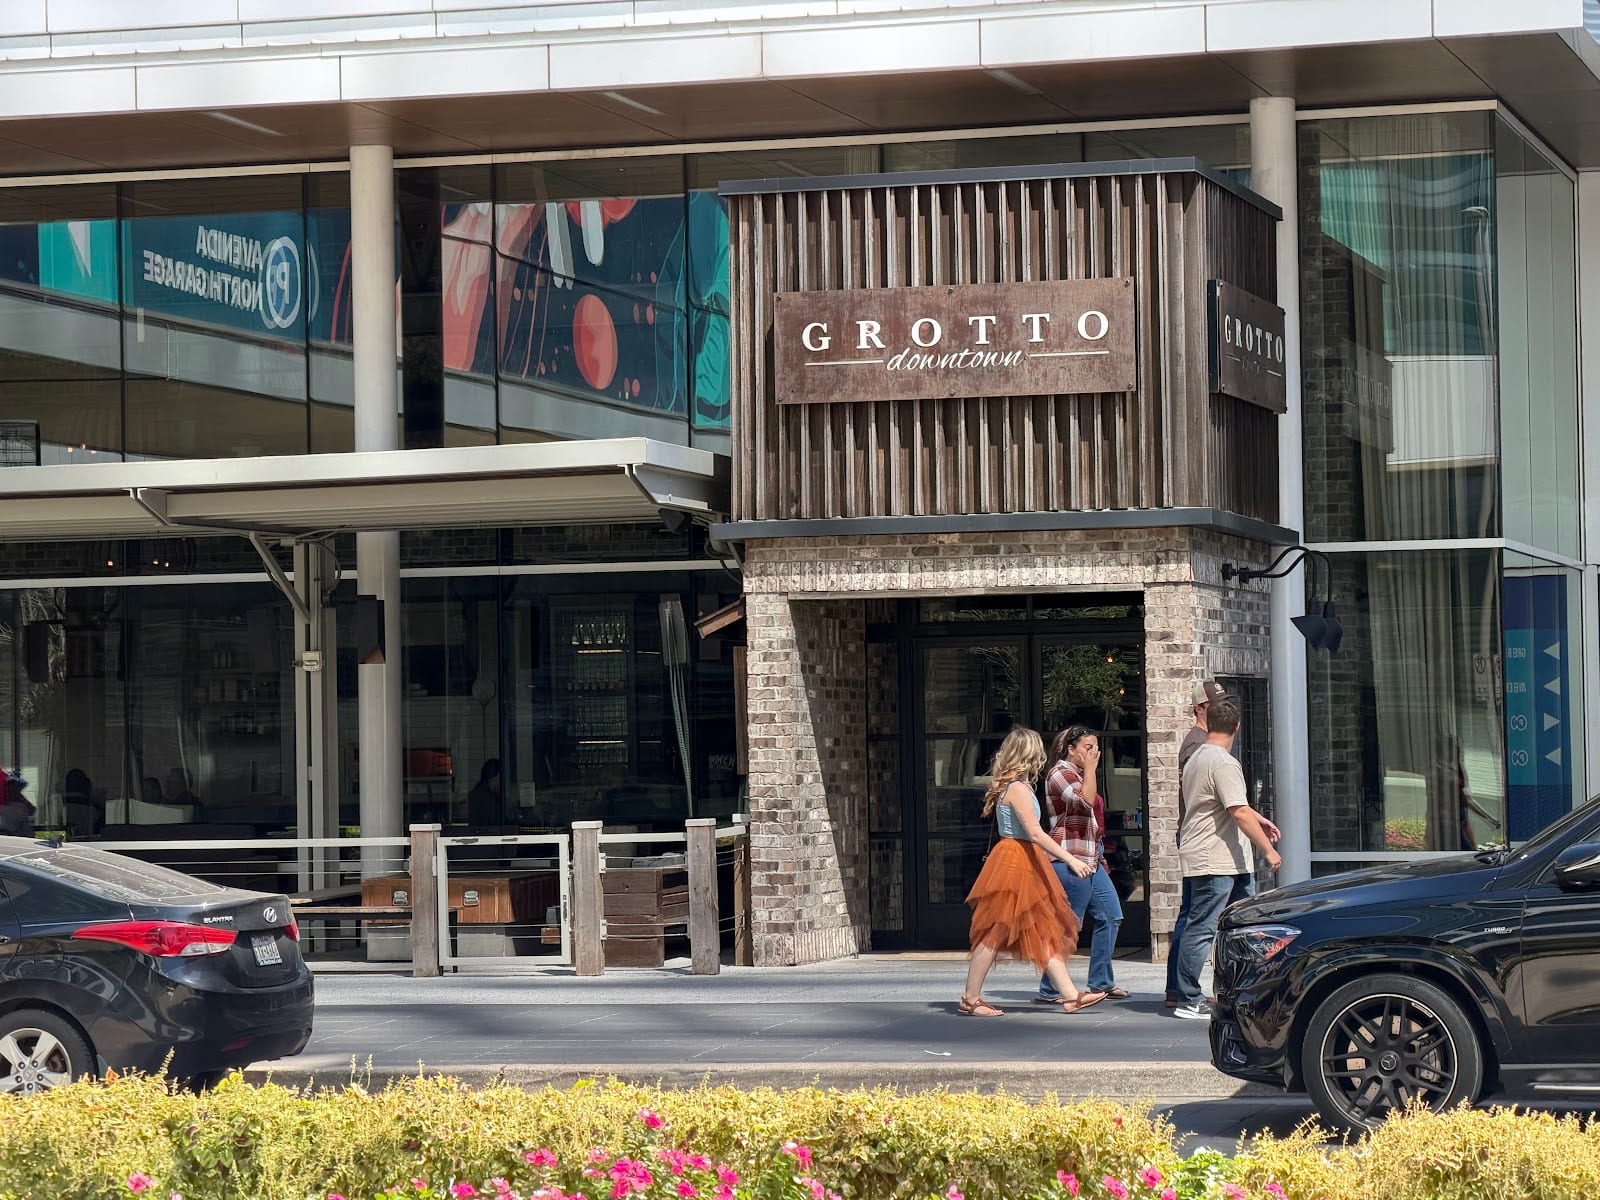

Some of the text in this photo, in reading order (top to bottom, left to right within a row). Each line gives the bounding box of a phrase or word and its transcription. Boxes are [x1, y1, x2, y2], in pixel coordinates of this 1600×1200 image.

[801, 310, 1110, 352] GROTTO
[1224, 314, 1283, 363] GROTTO
[887, 348, 1026, 371] downtown
[203, 916, 234, 924] ELANTRA
